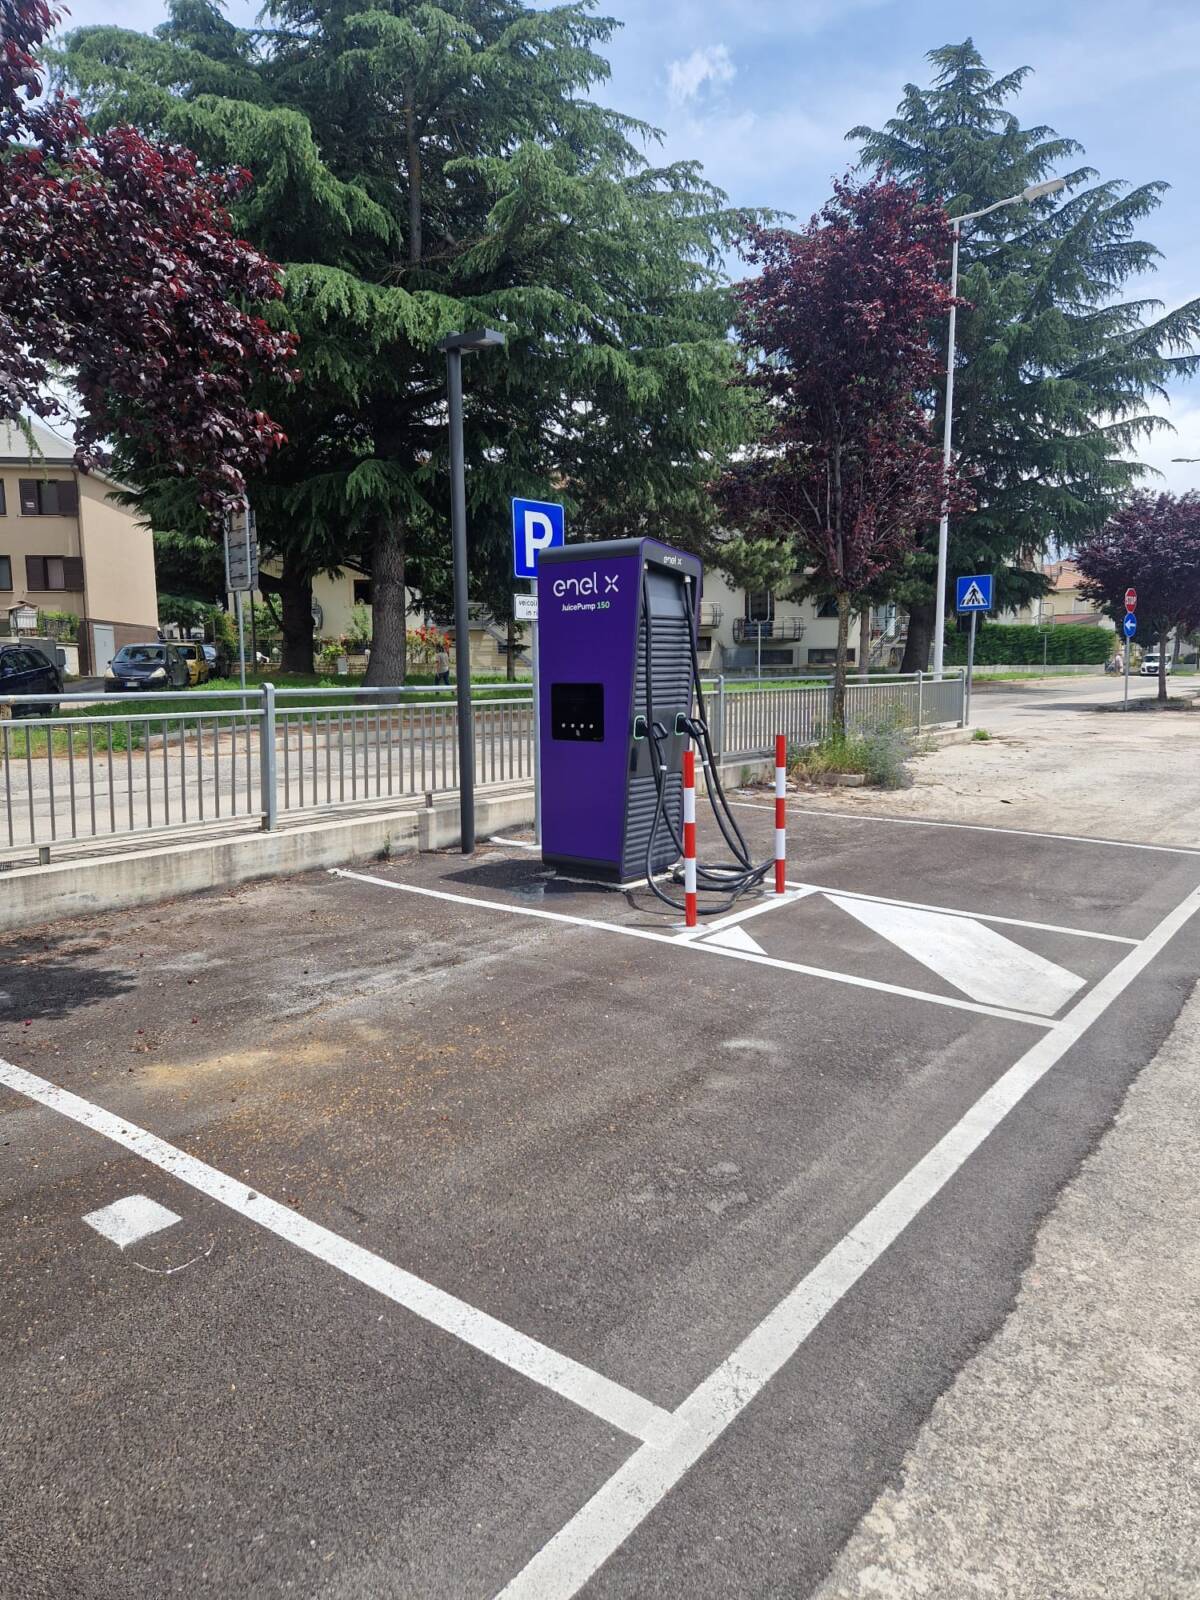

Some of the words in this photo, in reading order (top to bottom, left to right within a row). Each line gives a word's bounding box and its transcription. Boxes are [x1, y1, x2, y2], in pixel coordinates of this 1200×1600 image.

[524, 510, 553, 568] P
[553, 571, 599, 598] enel
[561, 602, 596, 612] JuicePump
[596, 600, 611, 610] 150
[1125, 596, 1136, 605] STOP
